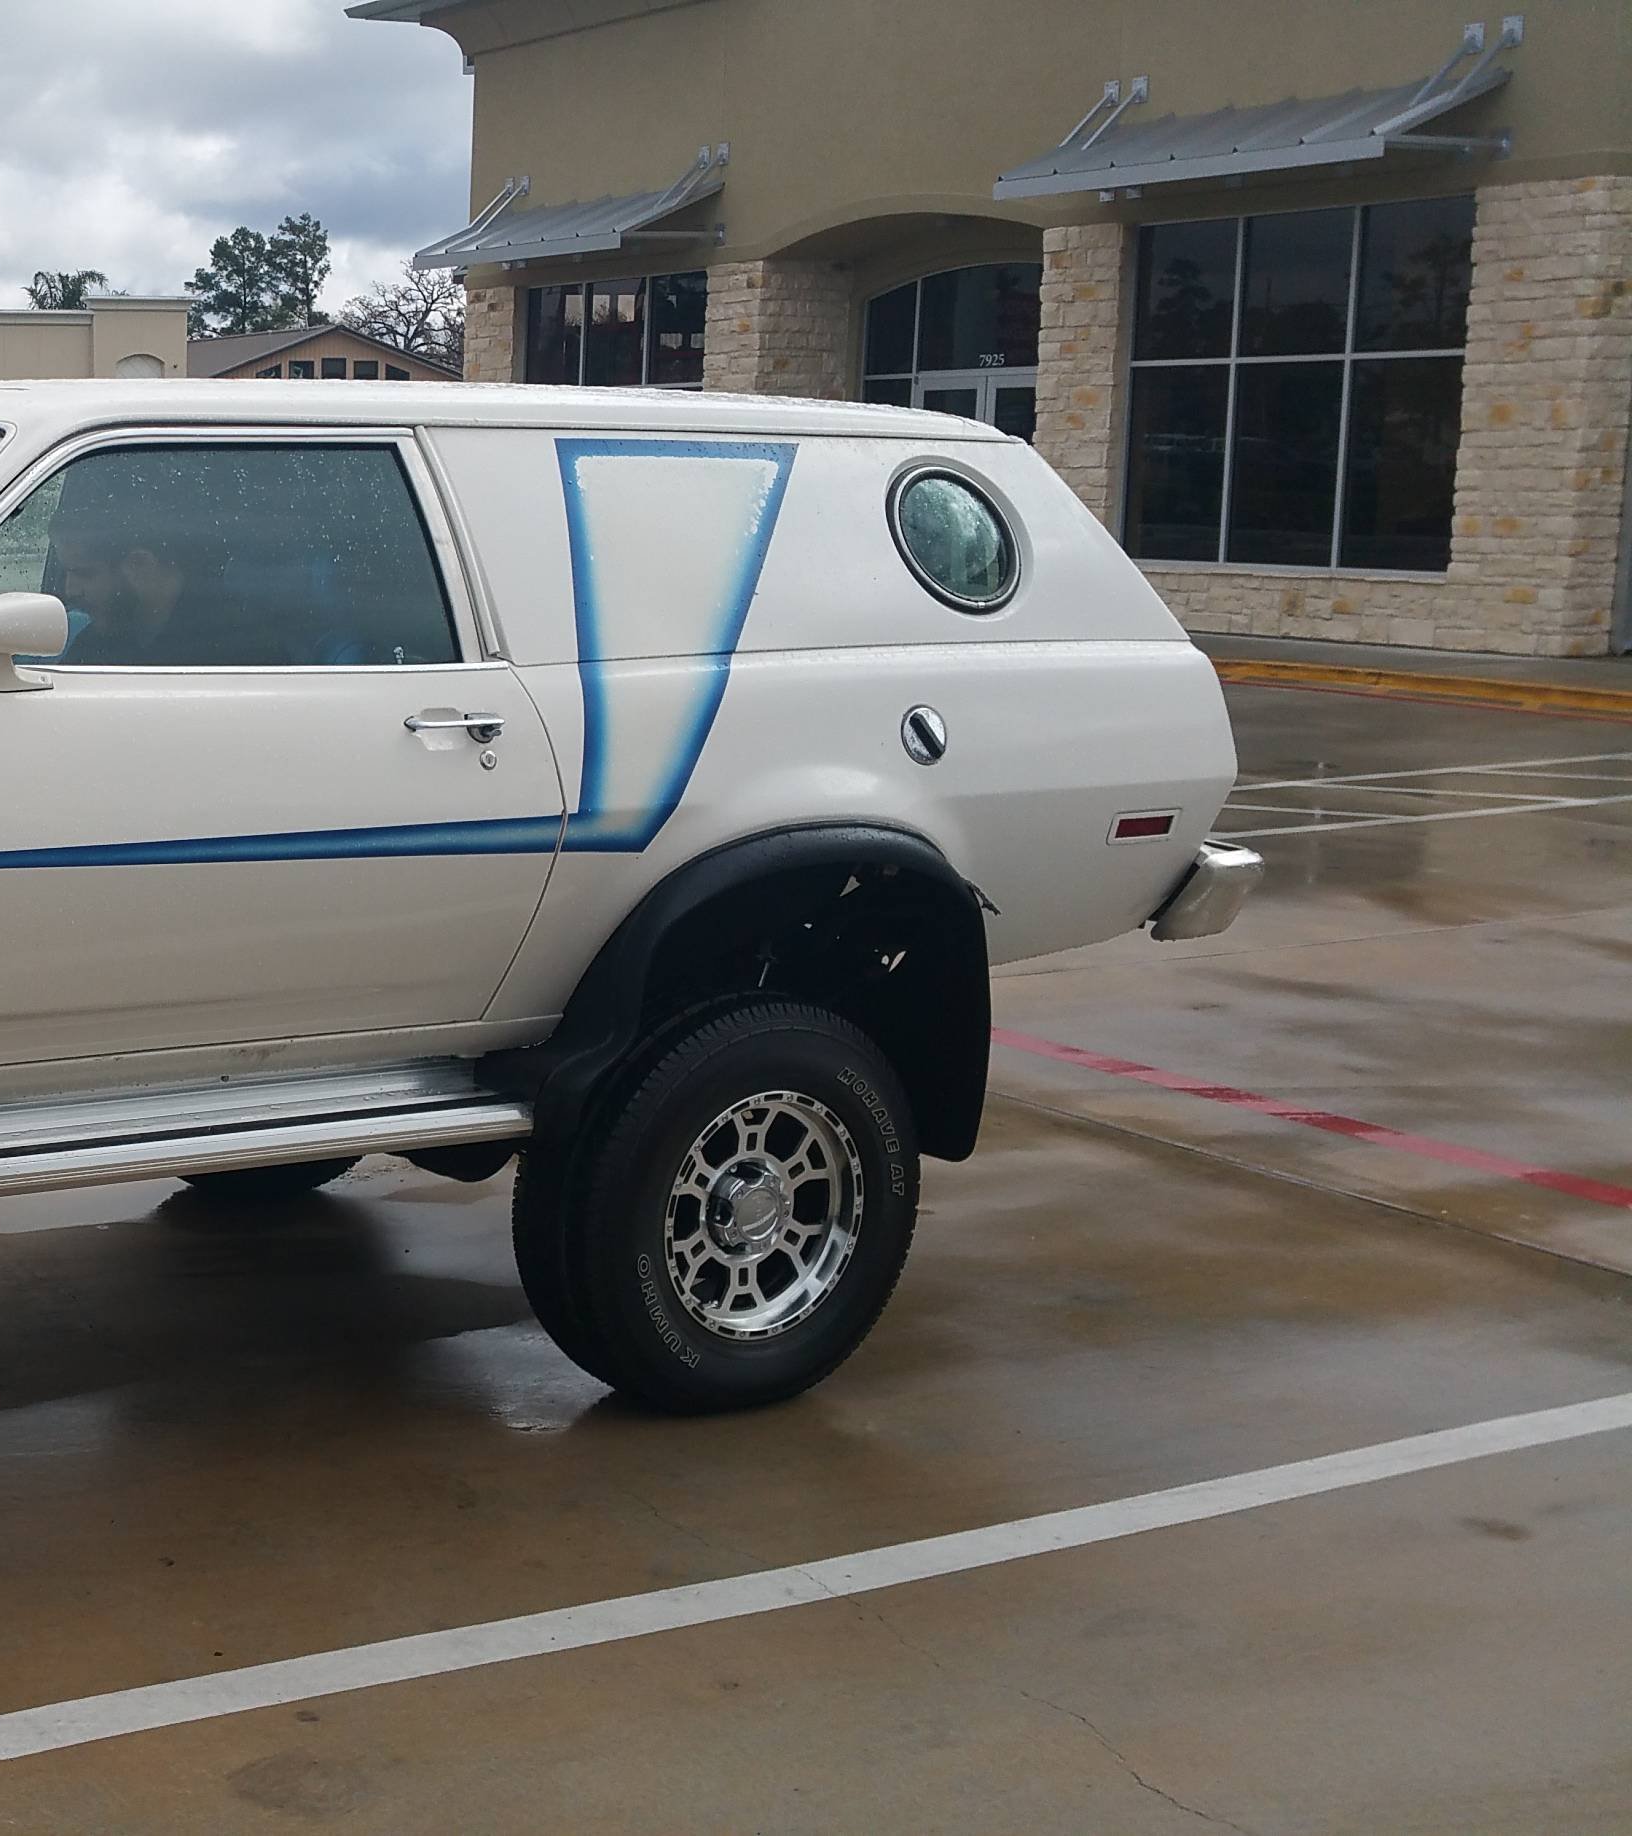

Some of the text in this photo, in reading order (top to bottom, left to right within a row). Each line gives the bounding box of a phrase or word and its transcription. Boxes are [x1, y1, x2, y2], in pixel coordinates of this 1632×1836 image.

[979, 354, 1005, 367] 7925
[837, 1067, 905, 1197] MOHAVE AT
[637, 1254, 702, 1369] KUMHO
